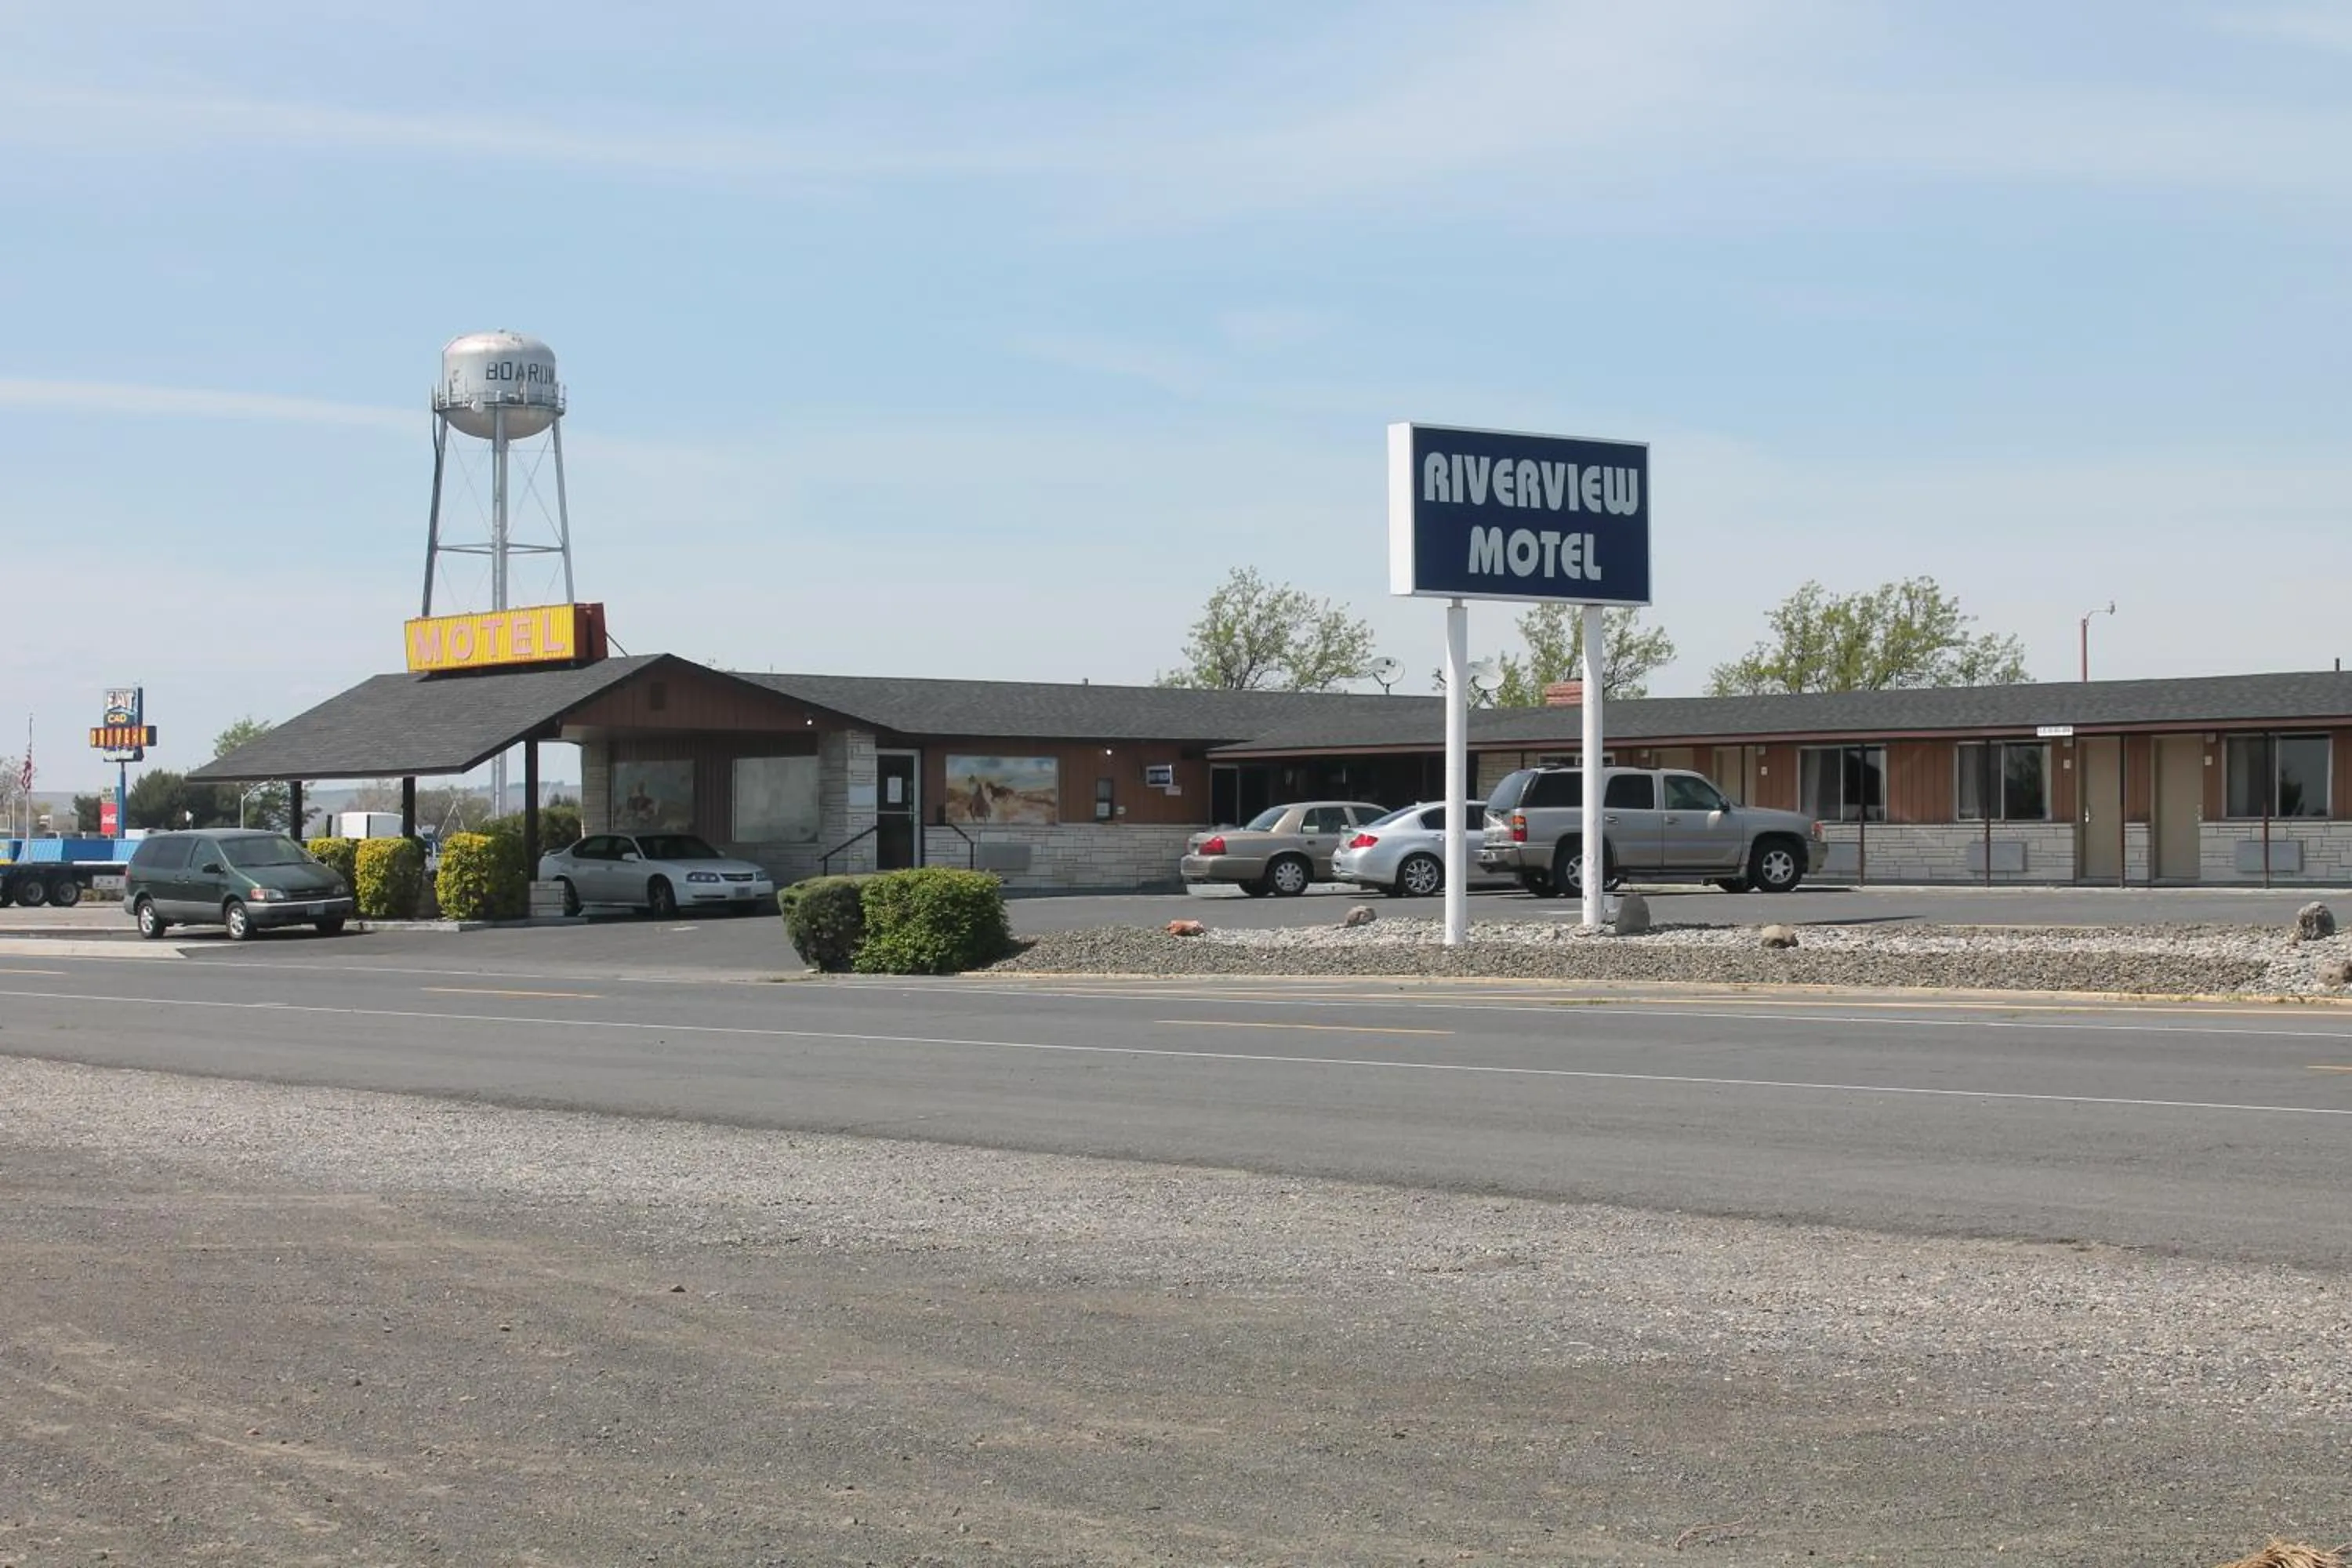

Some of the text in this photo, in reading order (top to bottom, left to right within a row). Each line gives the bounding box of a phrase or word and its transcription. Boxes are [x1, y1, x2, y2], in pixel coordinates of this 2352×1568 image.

[1424, 452, 1639, 515] RIVERVIEW
[1468, 525, 1602, 580] MOTEL
[413, 612, 565, 663] MOTEL
